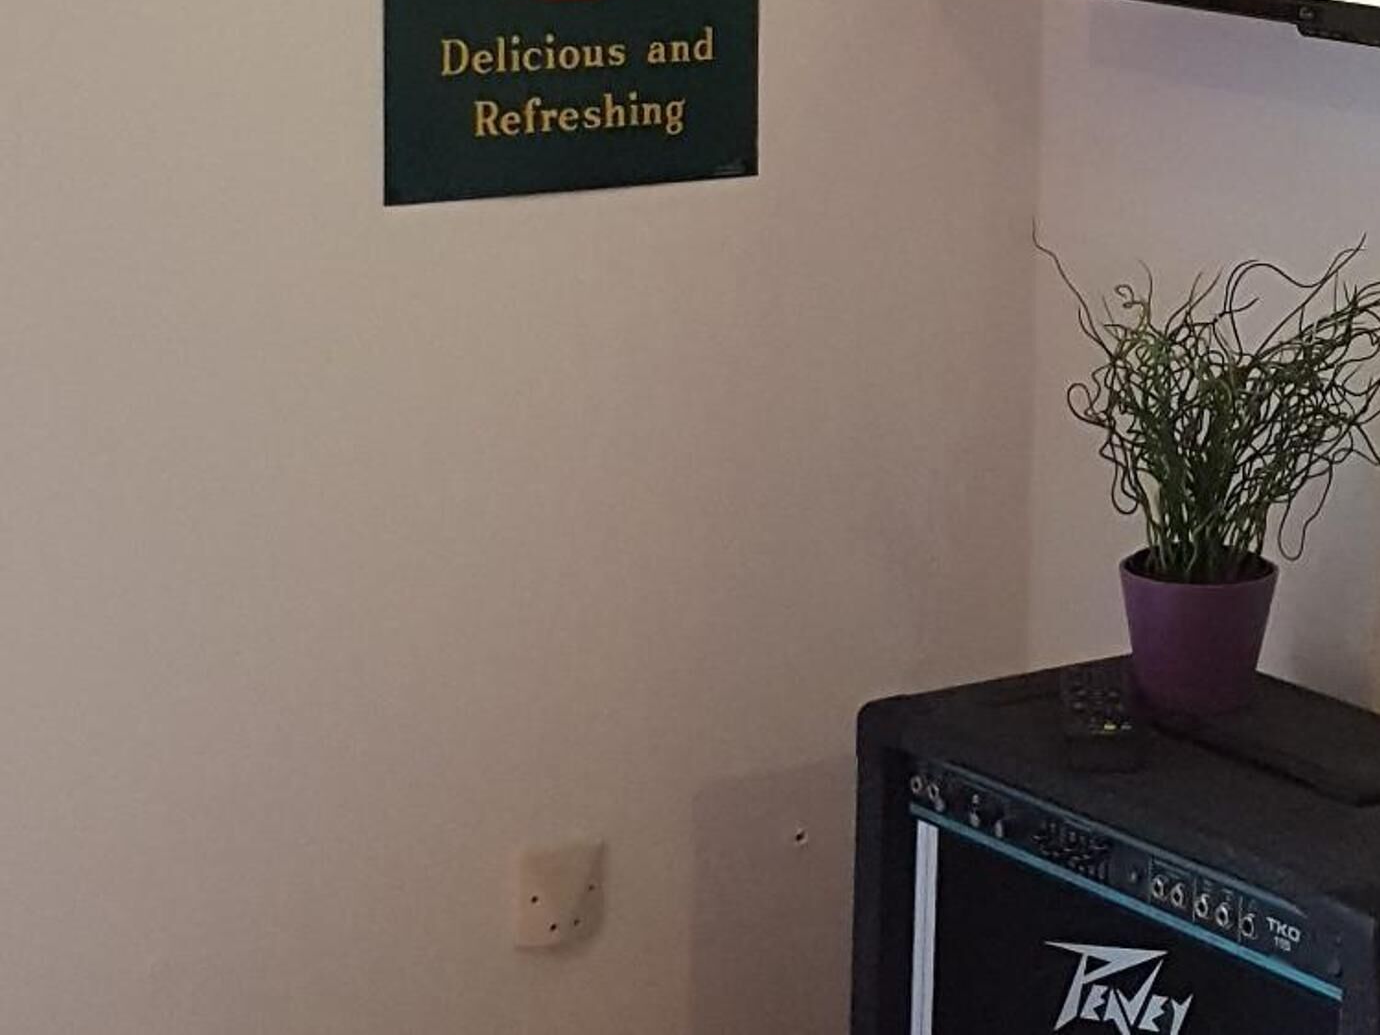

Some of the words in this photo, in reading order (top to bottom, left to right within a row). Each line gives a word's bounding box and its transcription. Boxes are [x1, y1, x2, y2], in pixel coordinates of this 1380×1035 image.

[441, 34, 626, 76] Delicious
[647, 26, 715, 64] and
[474, 91, 686, 136] Refreshing
[1265, 916, 1301, 943] TKO
[1044, 940, 1194, 1035] PEAVEY
